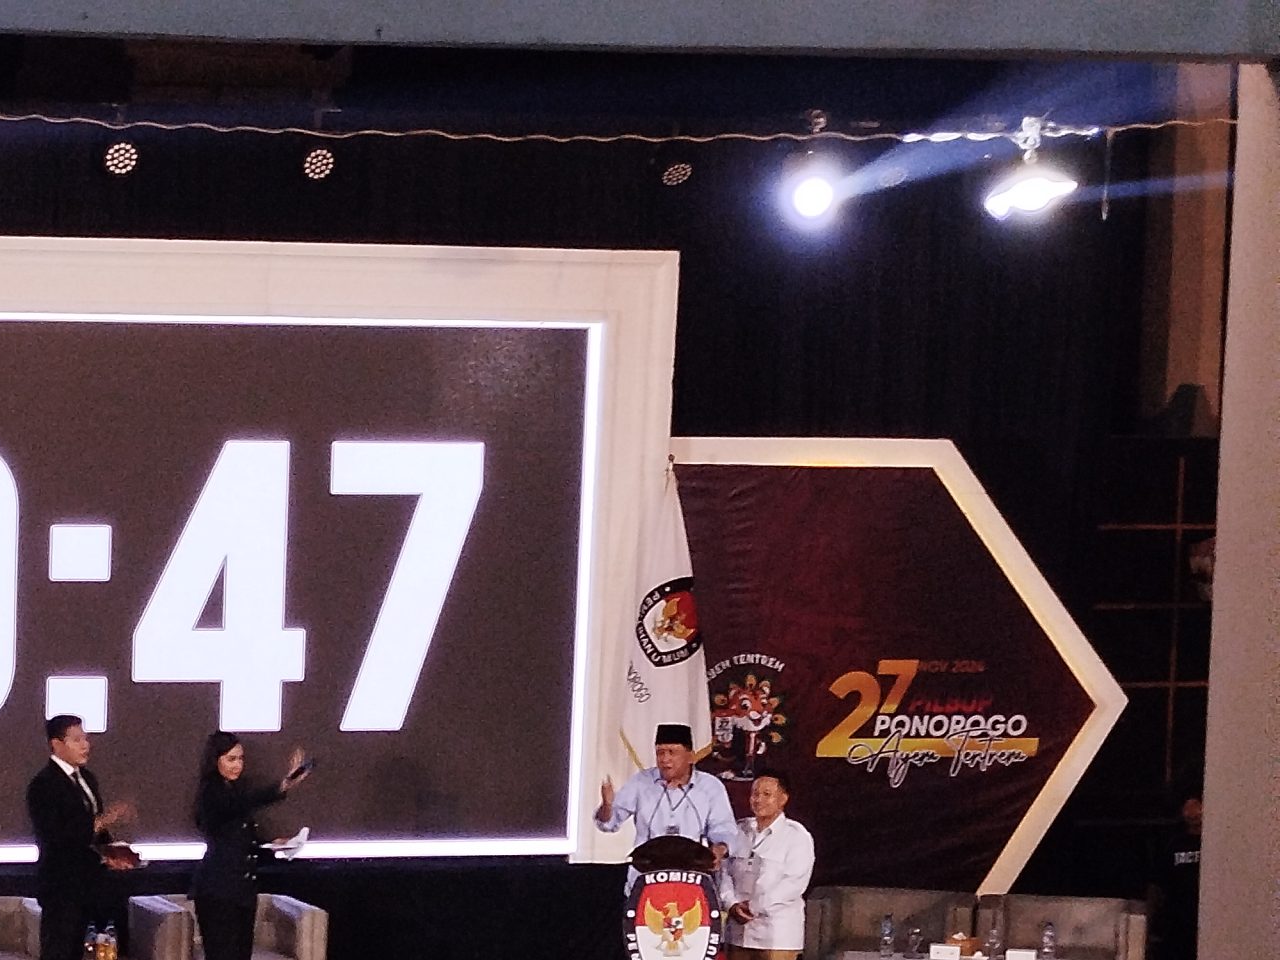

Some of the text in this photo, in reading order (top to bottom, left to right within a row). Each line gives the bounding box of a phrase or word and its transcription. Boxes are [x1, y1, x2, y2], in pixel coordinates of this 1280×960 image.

[707, 653, 786, 679] YEM TENTREM
[815, 659, 920, 758] 27
[873, 714, 1028, 737] PONOROGO
[645, 871, 702, 885] KOMISI
